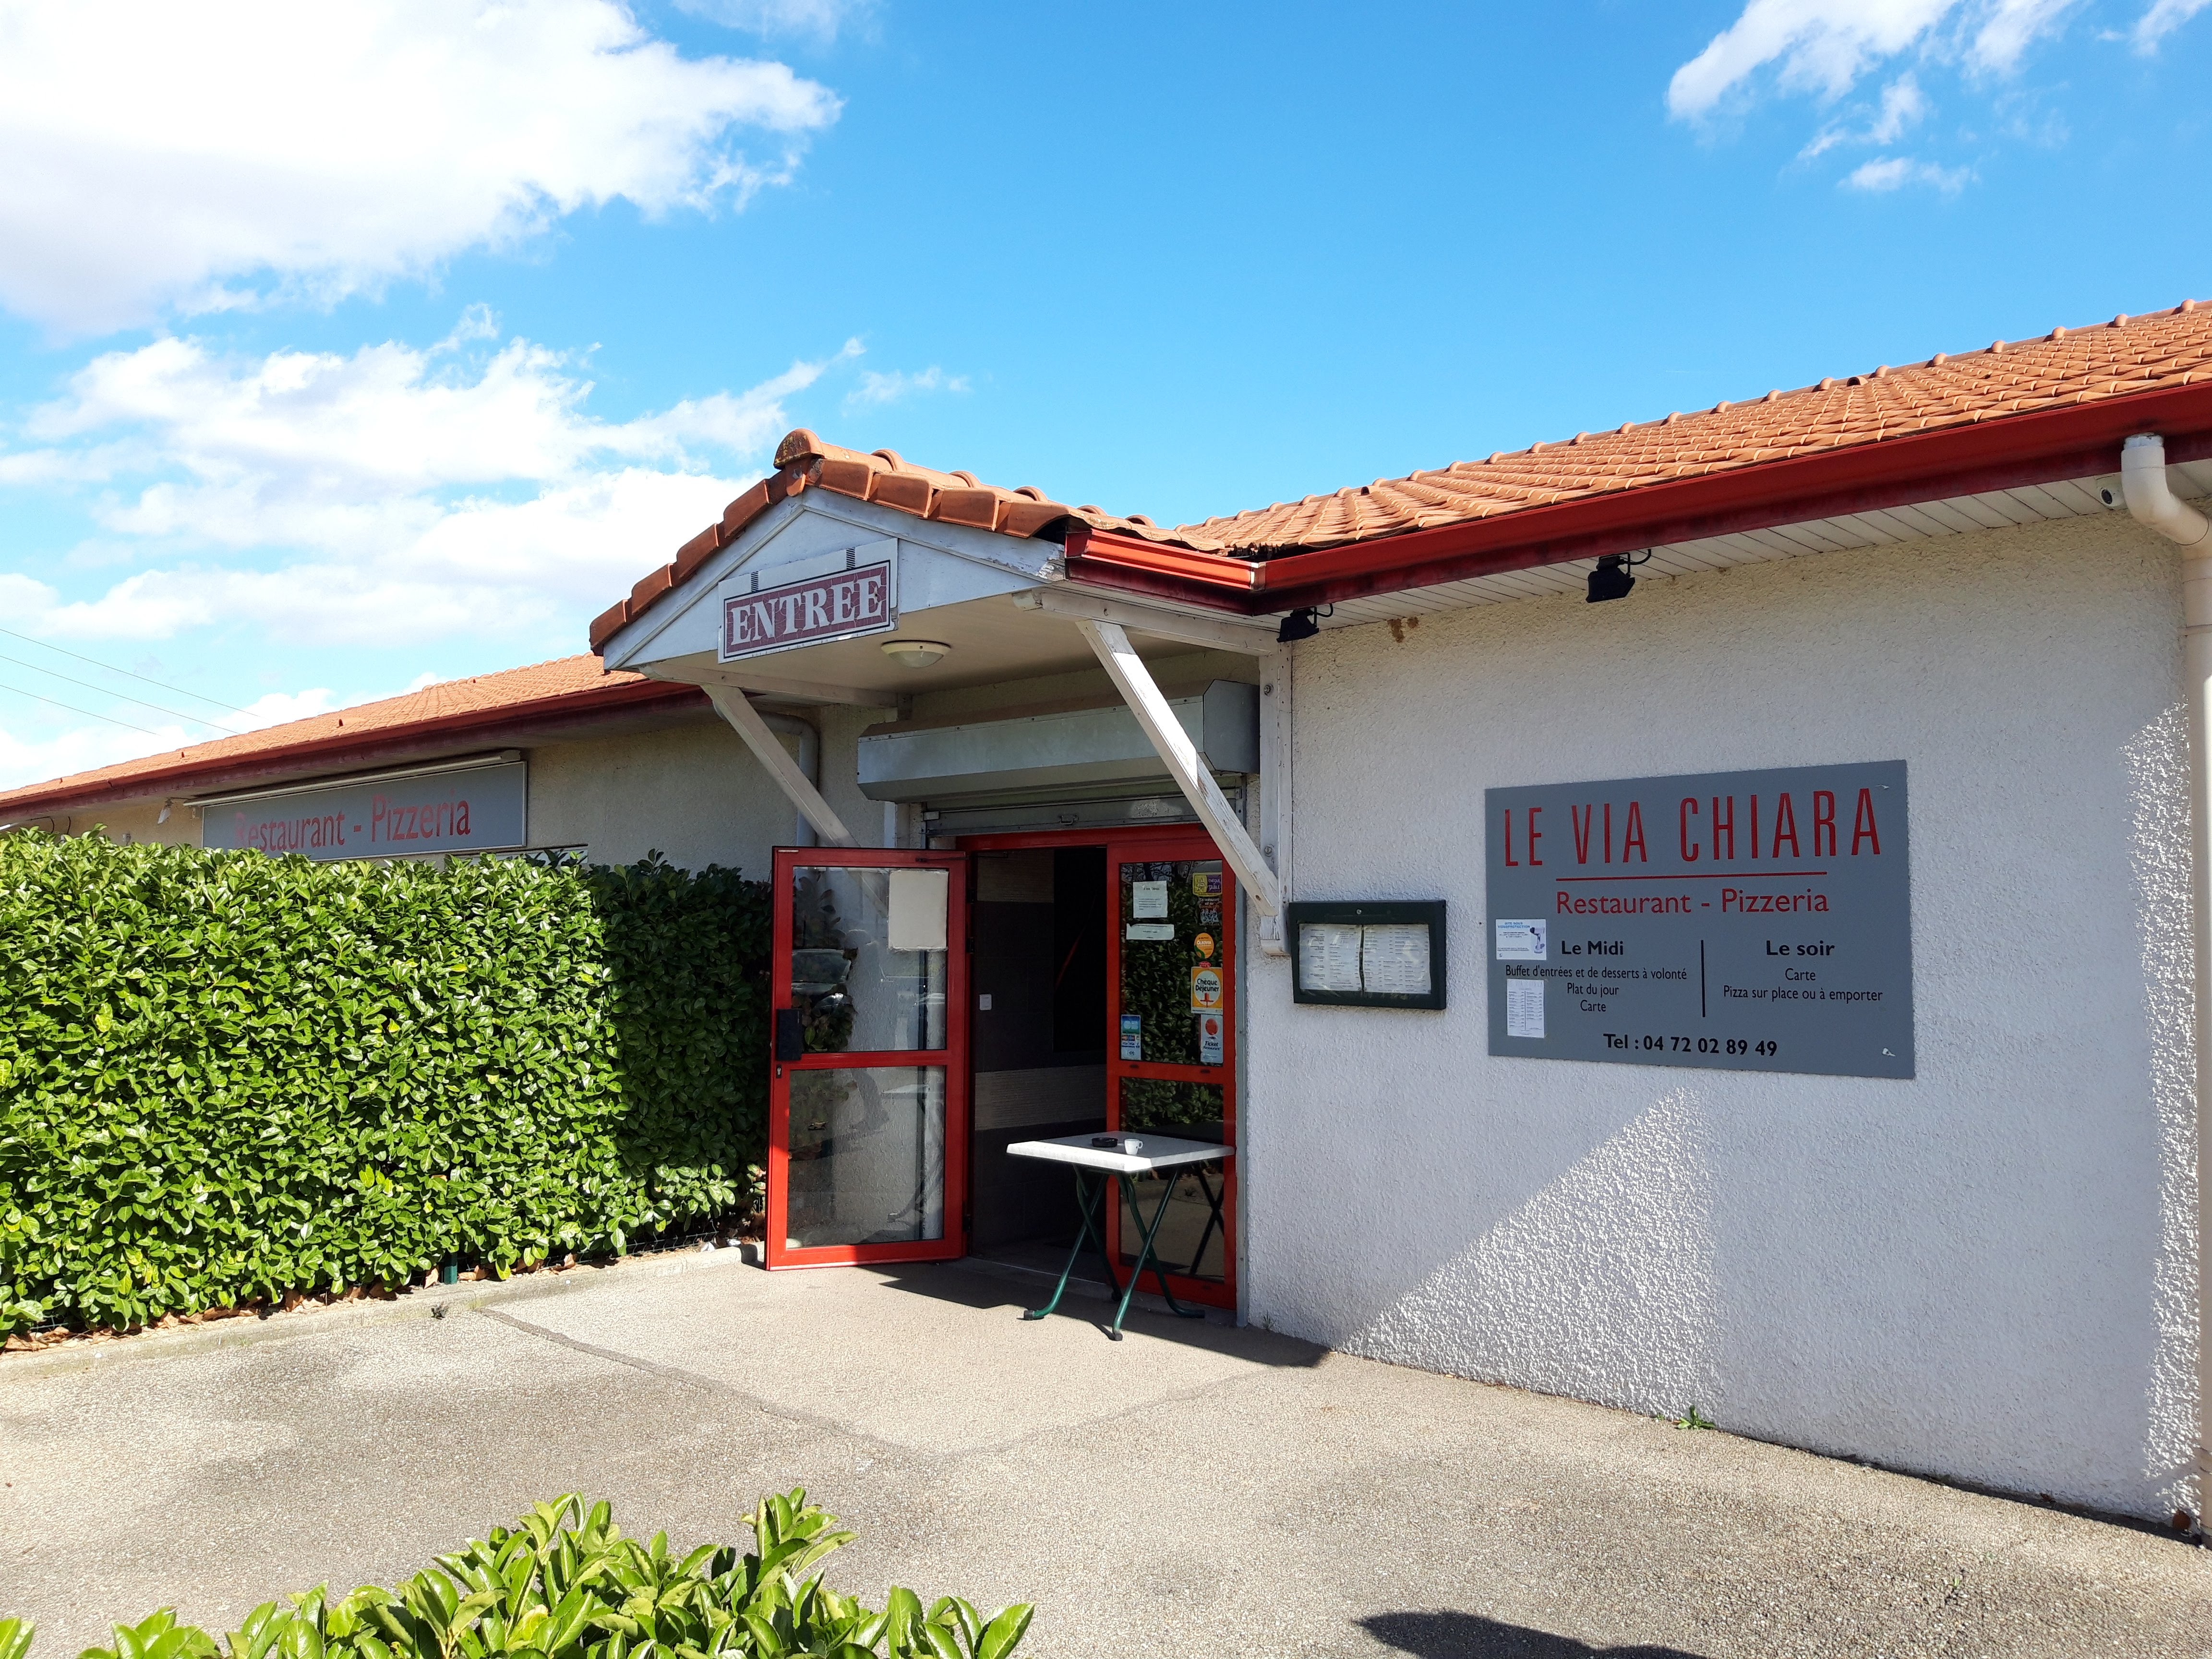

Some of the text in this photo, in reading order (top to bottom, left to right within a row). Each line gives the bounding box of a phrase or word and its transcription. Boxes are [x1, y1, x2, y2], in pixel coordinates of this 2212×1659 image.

[731, 575, 883, 646] ENTREE
[235, 811, 345, 852] Restaurant
[372, 789, 471, 842] Pizzeria
[1505, 788, 1881, 867] LE VIA CHIARA
[1557, 891, 1691, 914] Restaurant
[1722, 888, 1829, 913] Pizzeria
[1562, 940, 1624, 955] Le Midi
[1766, 940, 1835, 956] Le soir
[1505, 964, 1687, 980] Buffet d'entrées et de desserts à volonté
[1785, 968, 1816, 981] Carte
[1567, 982, 1619, 998] Plat du jour
[1723, 985, 1883, 1004] Pizza sur place ou à emporter
[1580, 999, 1607, 1012] Carte
[1603, 1033, 1628, 1049] Tel
[1643, 1035, 1664, 1051] 04
[1670, 1036, 1691, 1052] 72
[1697, 1037, 1719, 1054] 02
[1726, 1039, 1748, 1055] 89
[1755, 1040, 1777, 1057] 49
